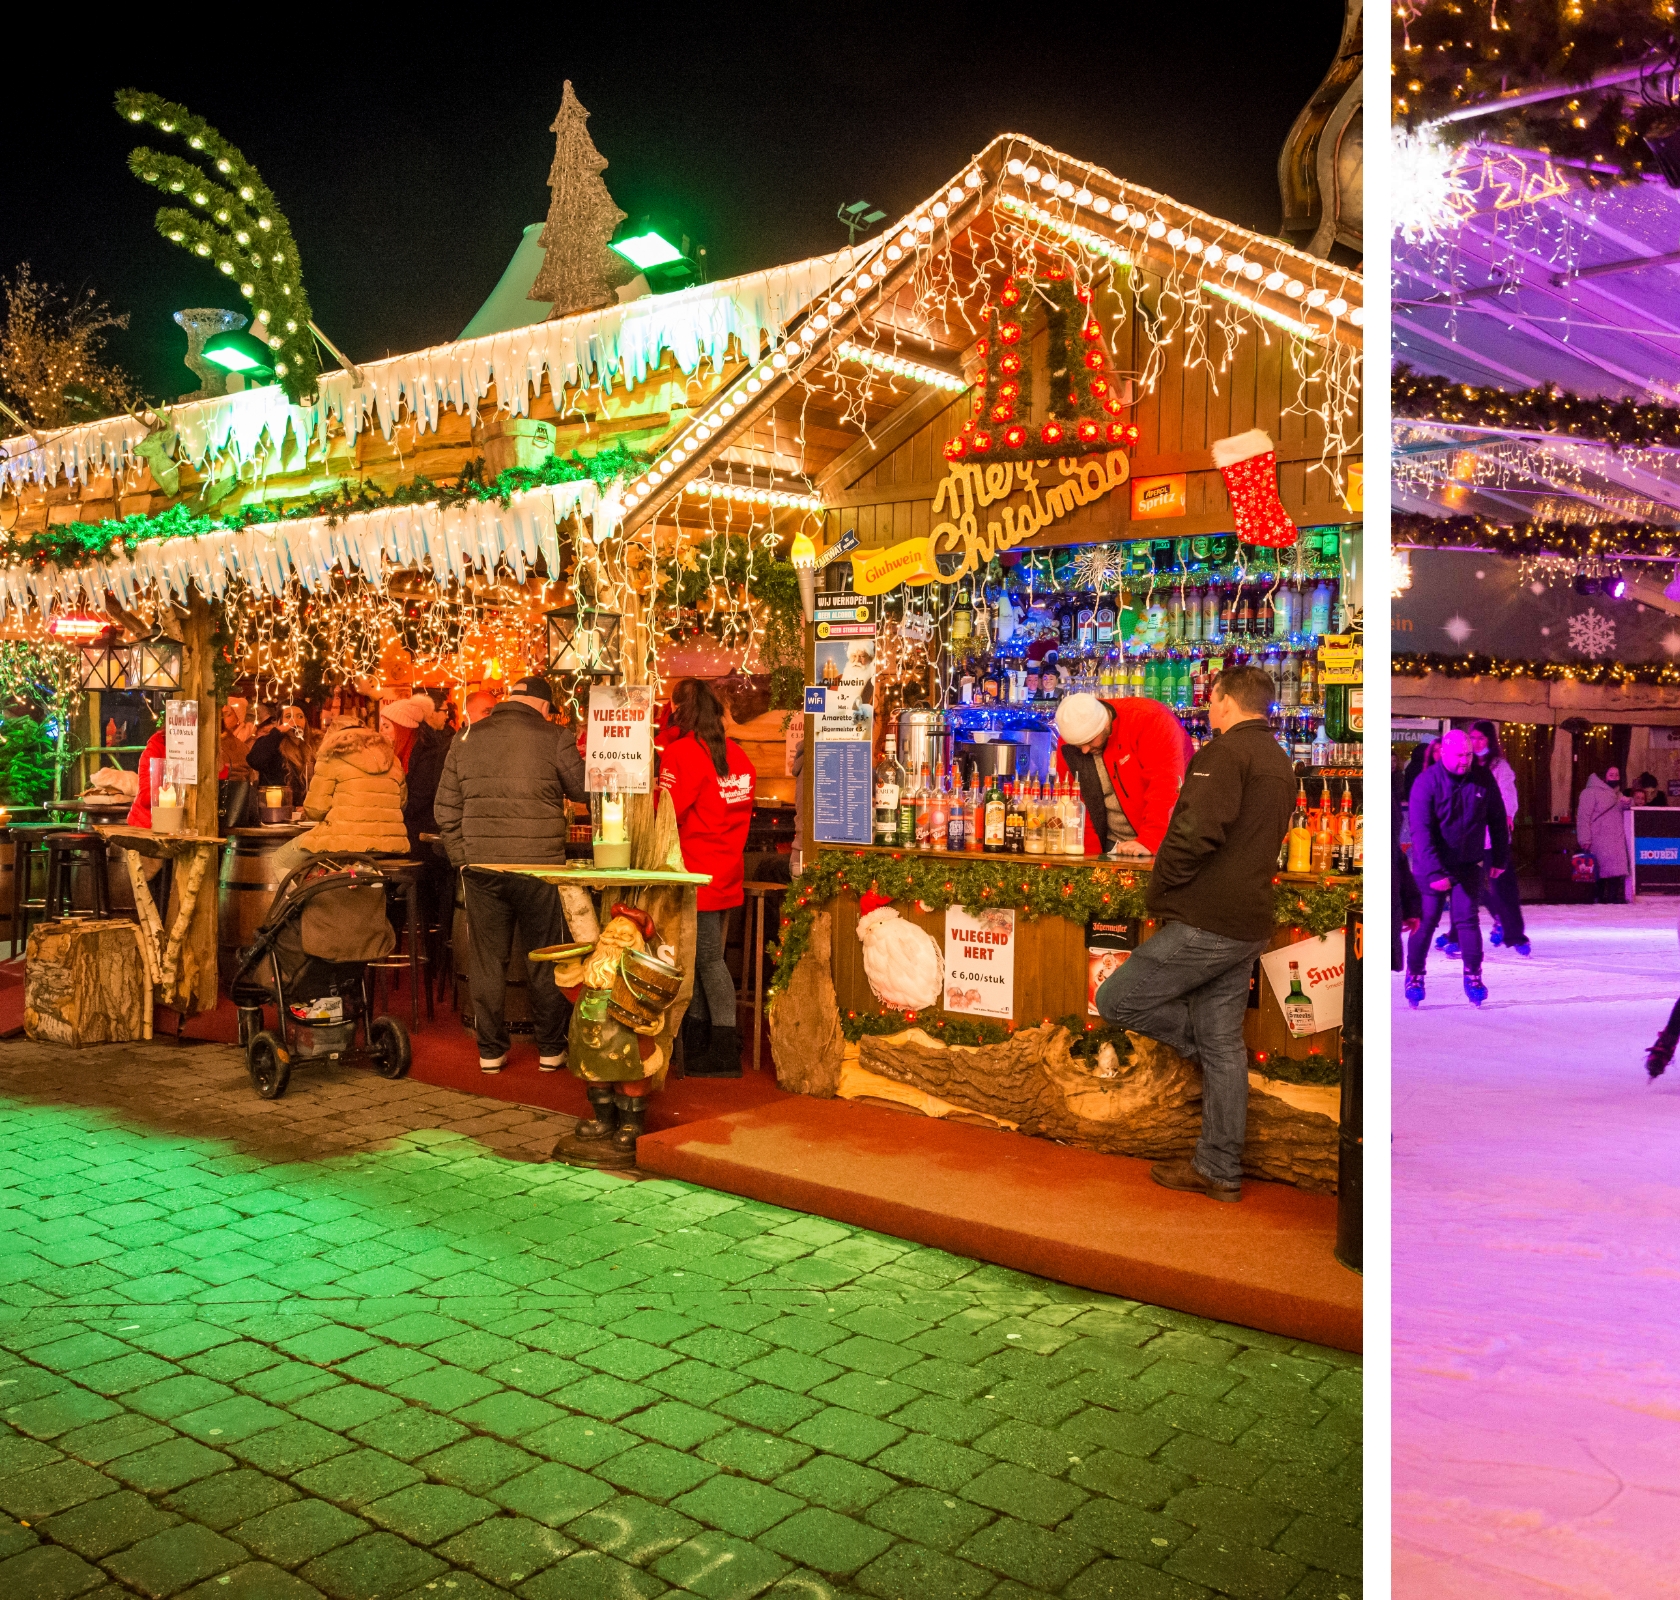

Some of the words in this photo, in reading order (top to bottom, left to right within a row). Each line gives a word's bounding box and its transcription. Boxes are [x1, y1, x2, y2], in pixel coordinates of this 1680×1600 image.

[1145, 486, 1169, 499] APEROL
[1138, 493, 1176, 512] Spritz
[926, 449, 1130, 584] Christmas
[865, 550, 922, 583] Gluhwein
[817, 597, 831, 607] WIJ
[807, 697, 823, 705] WiFi
[593, 709, 645, 722] VLIEGEND
[603, 725, 632, 738] HERT
[790, 721, 805, 731] GLÜ
[598, 750, 642, 761] 6,00/stuk
[1318, 768, 1337, 776] ICE
[901, 806, 912, 833] MINT
[1640, 850, 1678, 859] HOUBEN
[951, 928, 1008, 946] VLIEGEND
[963, 946, 994, 961] HERT
[951, 970, 957, 979] €
[959, 971, 1005, 985] 6,00/stuk
